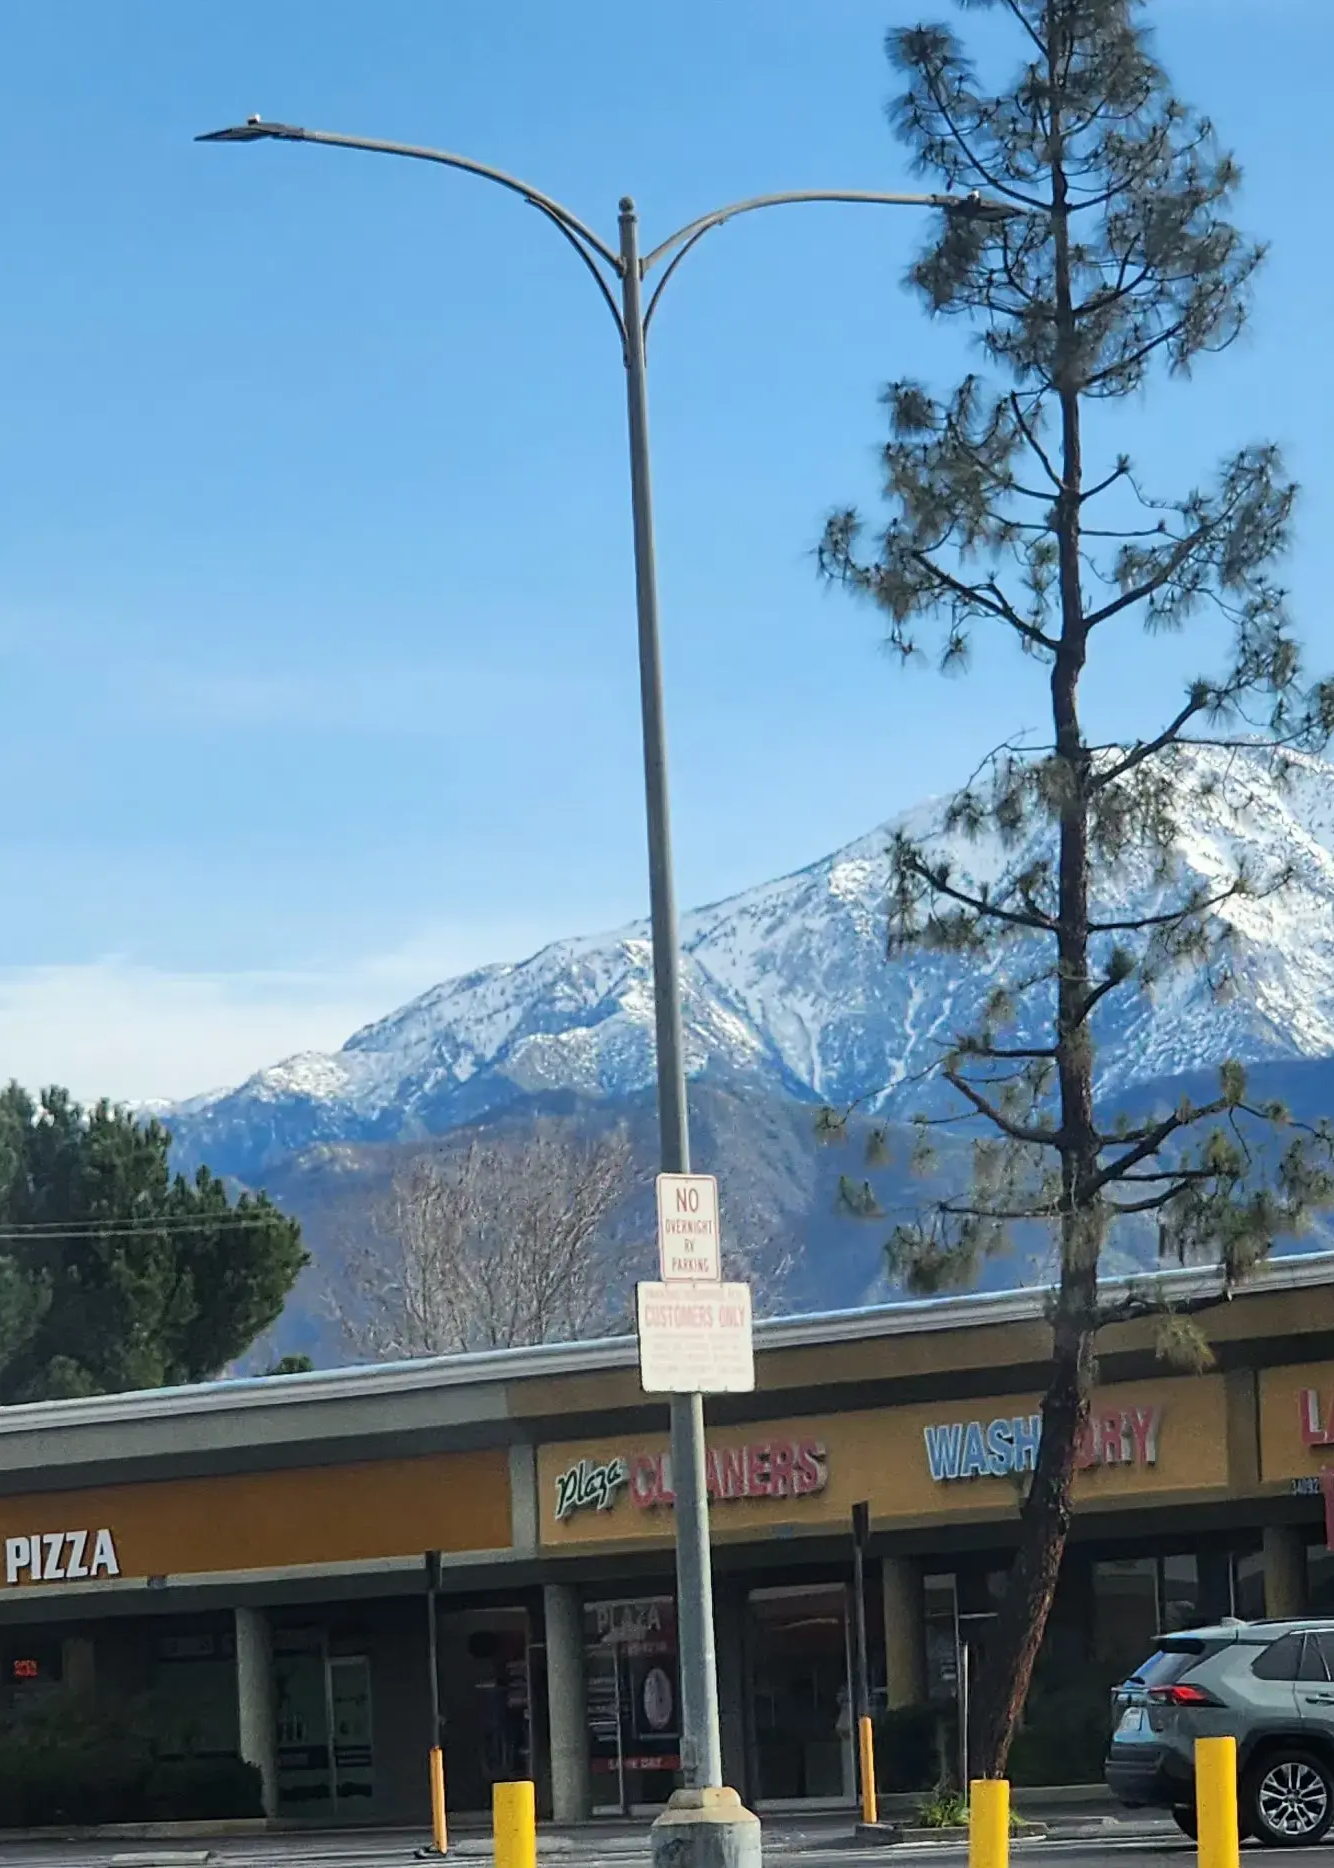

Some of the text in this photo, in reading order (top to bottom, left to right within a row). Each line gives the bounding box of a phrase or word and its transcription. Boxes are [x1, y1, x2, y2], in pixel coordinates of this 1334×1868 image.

[676, 1187, 699, 1213] NO
[665, 1218, 713, 1235] OVERNIGHT
[671, 1257, 709, 1273] PARKING
[644, 1304, 746, 1328] CUSTOMERS ONLY
[923, 1414, 1042, 1481] WASH
[554, 1440, 828, 1519] Plaza CLANERS
[5, 1528, 119, 1584] PIZZA
